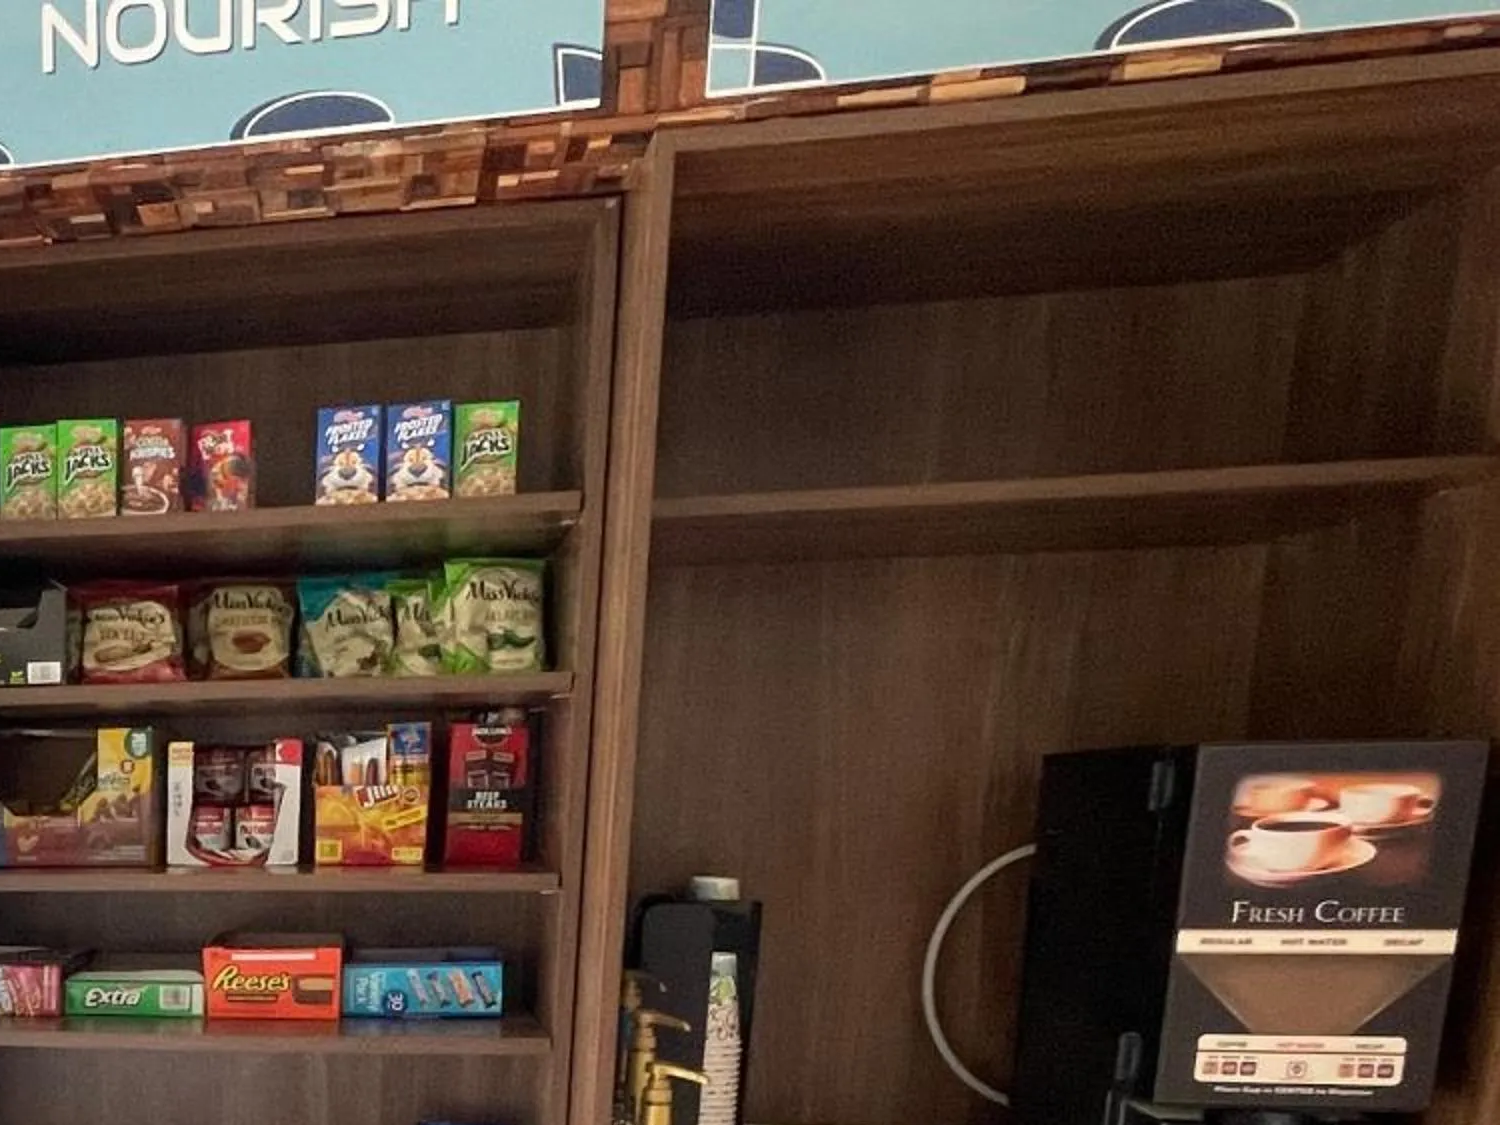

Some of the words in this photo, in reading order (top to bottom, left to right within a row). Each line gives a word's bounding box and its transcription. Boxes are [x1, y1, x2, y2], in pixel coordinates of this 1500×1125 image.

[1231, 900, 1304, 924] FRESH
[1315, 900, 1405, 924] COFFEE
[212, 964, 291, 992] Reese's
[85, 987, 143, 1007] Extra
